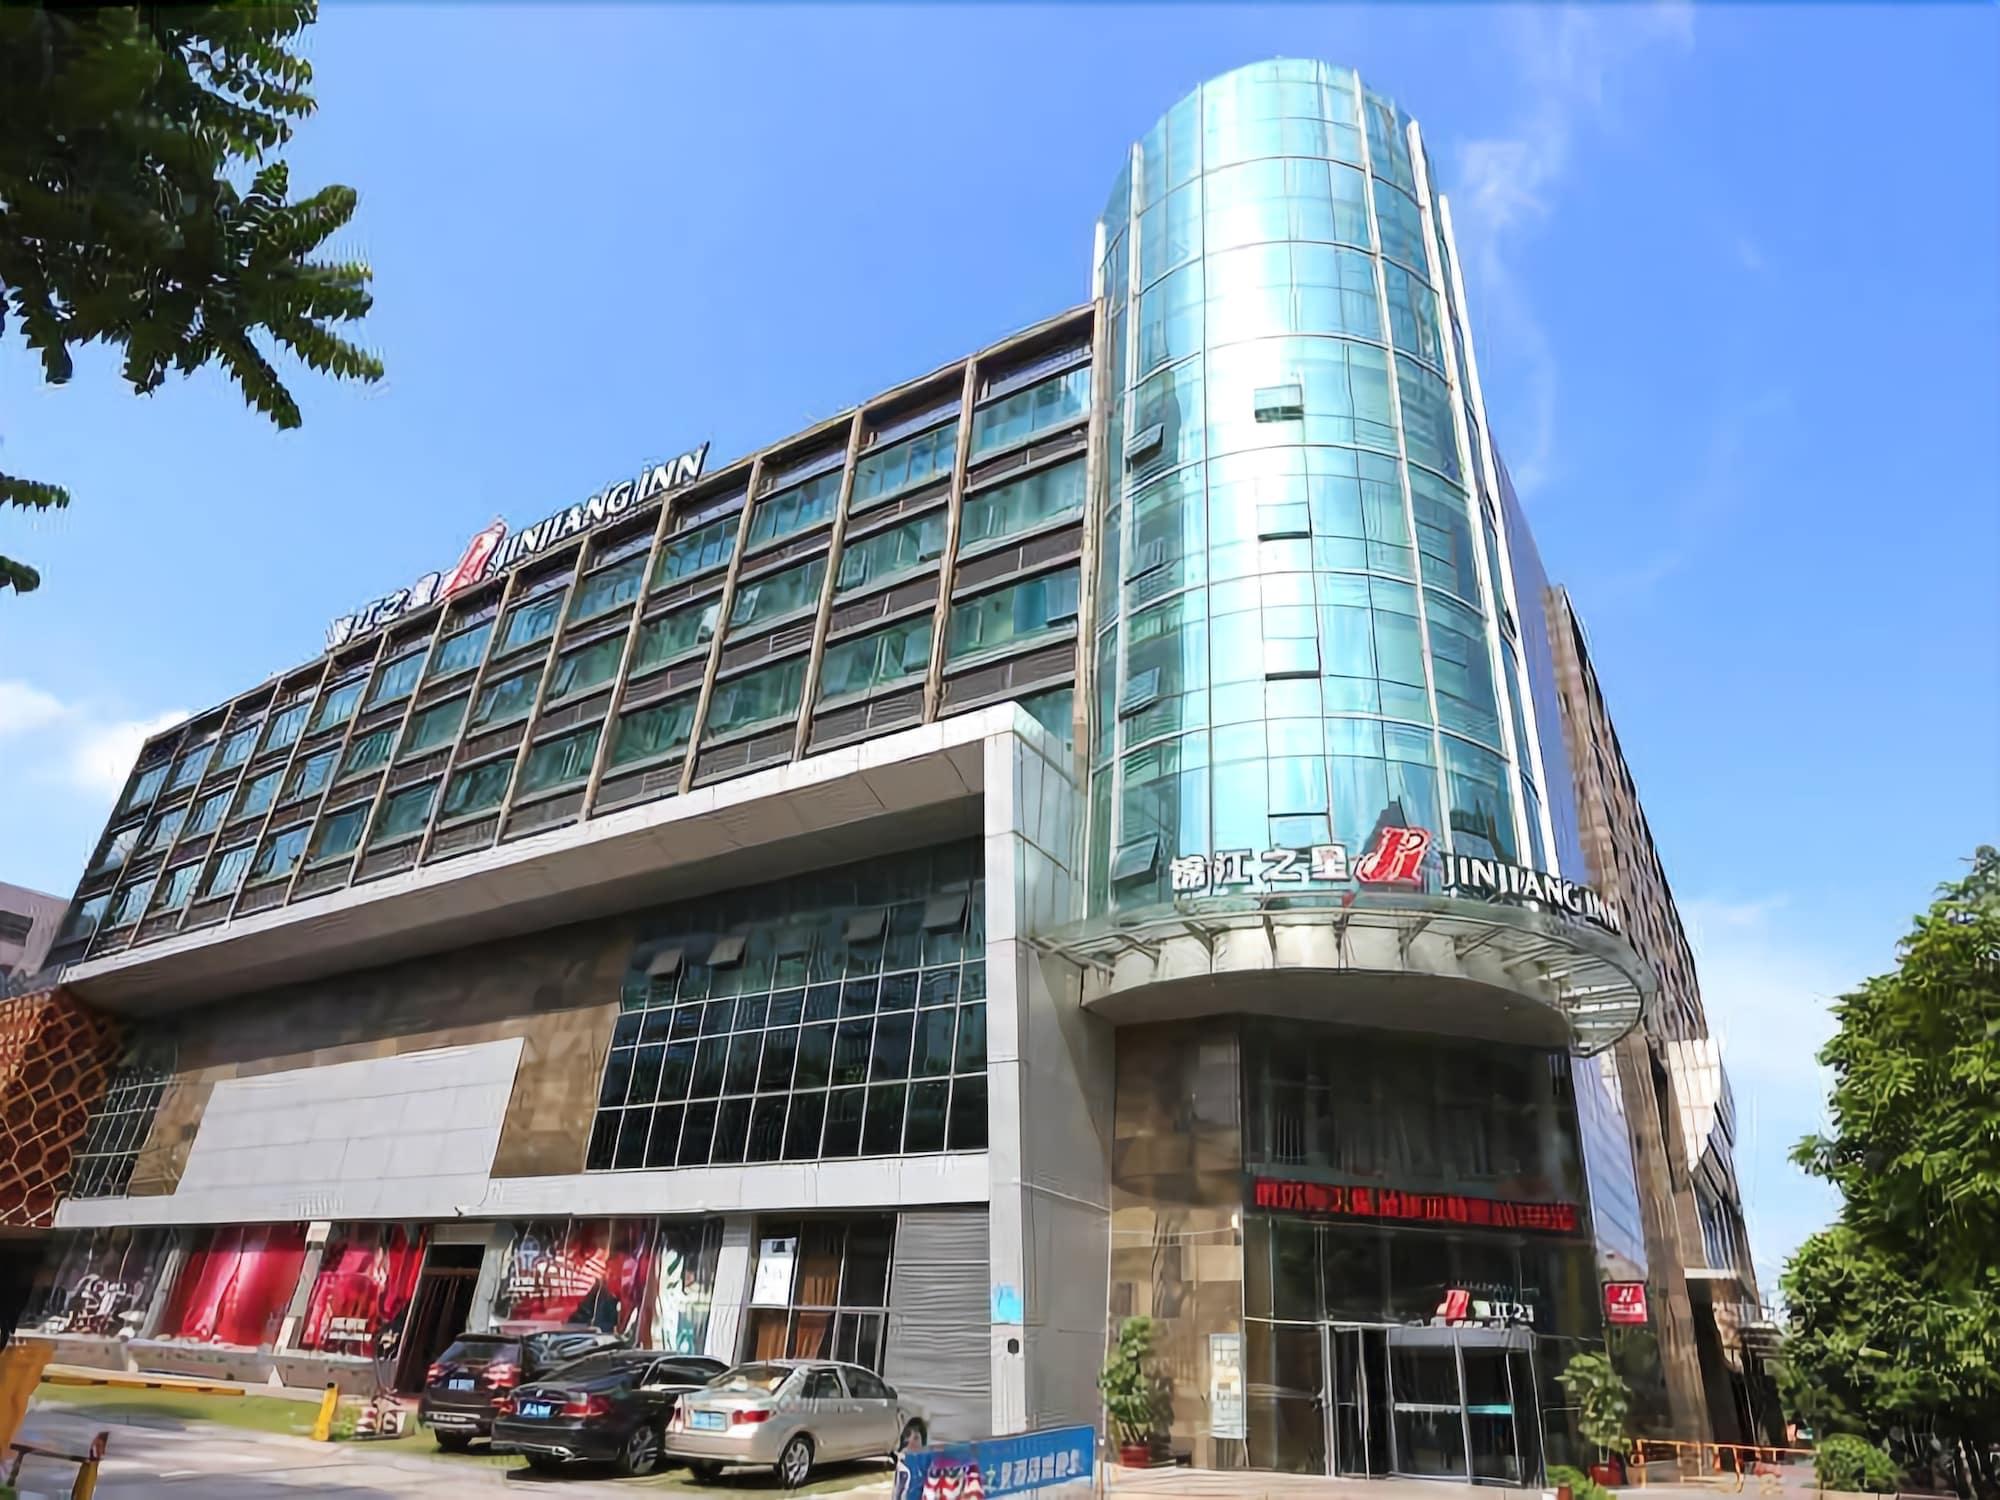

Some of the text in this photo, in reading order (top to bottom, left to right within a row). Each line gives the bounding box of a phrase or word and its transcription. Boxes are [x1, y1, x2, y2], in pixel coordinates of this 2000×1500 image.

[491, 443, 709, 574] JINJIANG INN
[1441, 855, 1582, 913] JINJIANG
